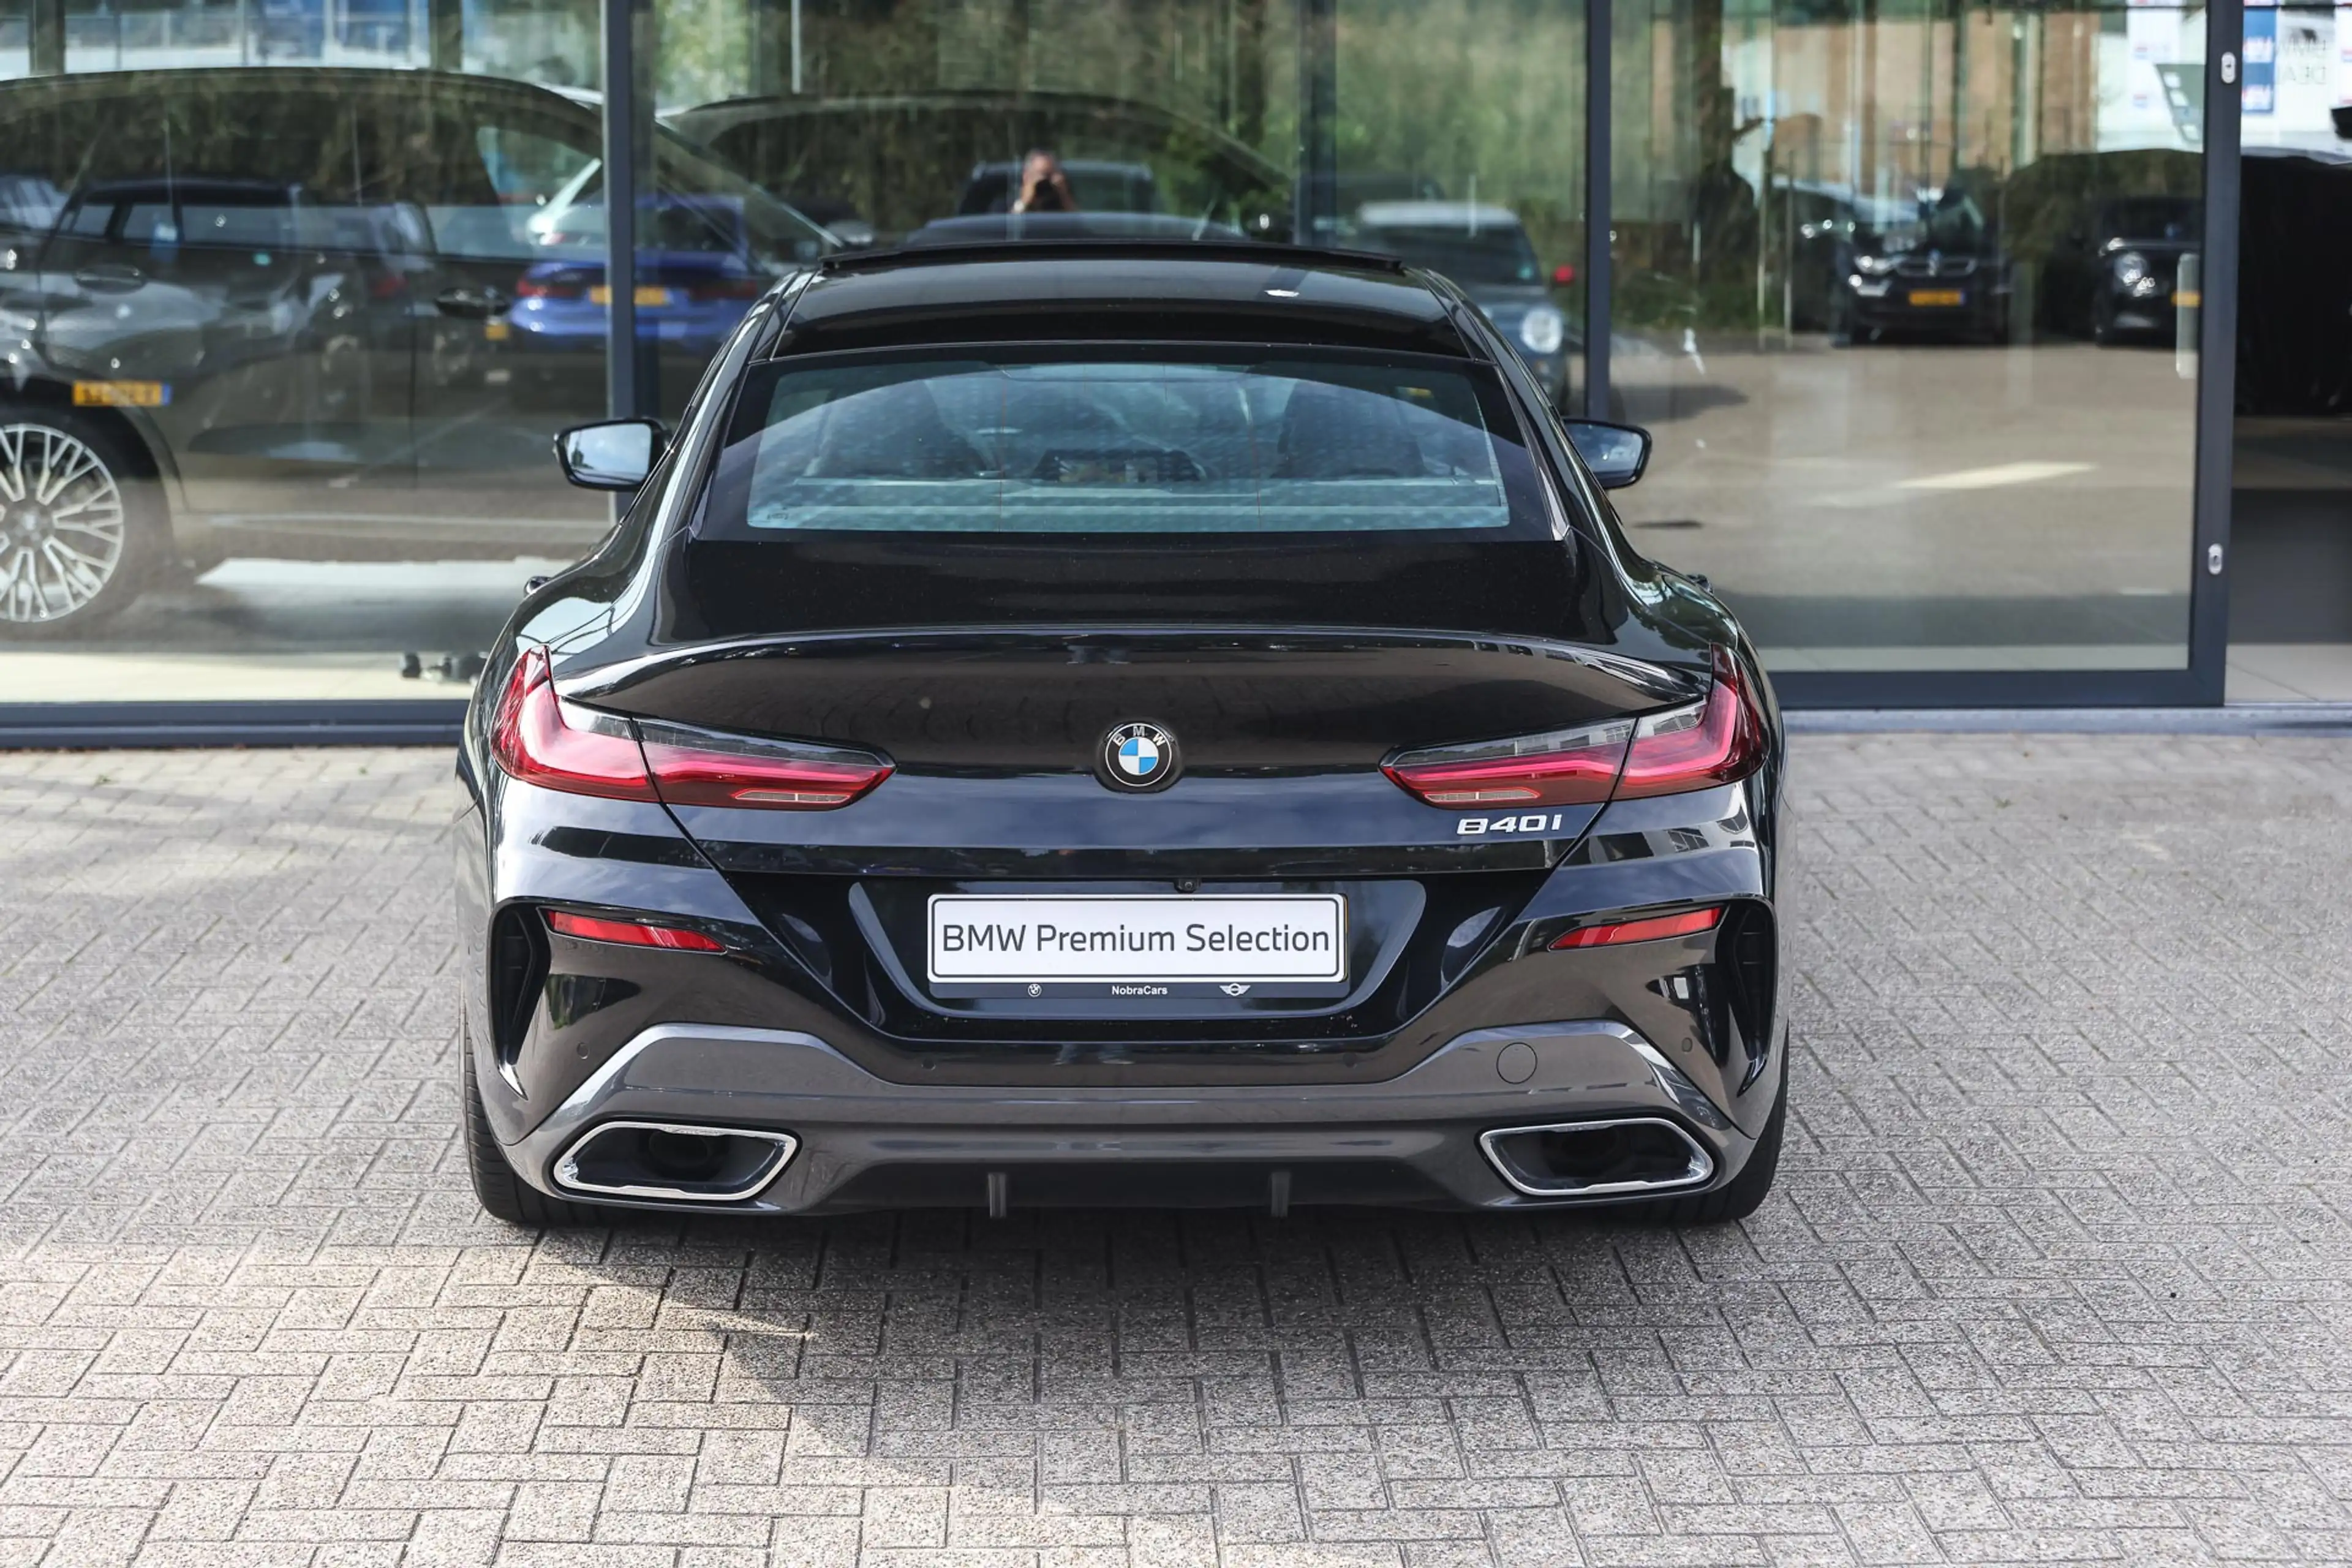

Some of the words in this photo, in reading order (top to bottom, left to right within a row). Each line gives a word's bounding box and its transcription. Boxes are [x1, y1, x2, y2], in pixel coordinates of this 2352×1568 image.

[1112, 725, 1166, 747] BMW
[943, 924, 1027, 951] BMW
[1037, 924, 1175, 952] Premium
[1186, 924, 1329, 952] Selection
[1112, 985, 1168, 995] NobraCars
